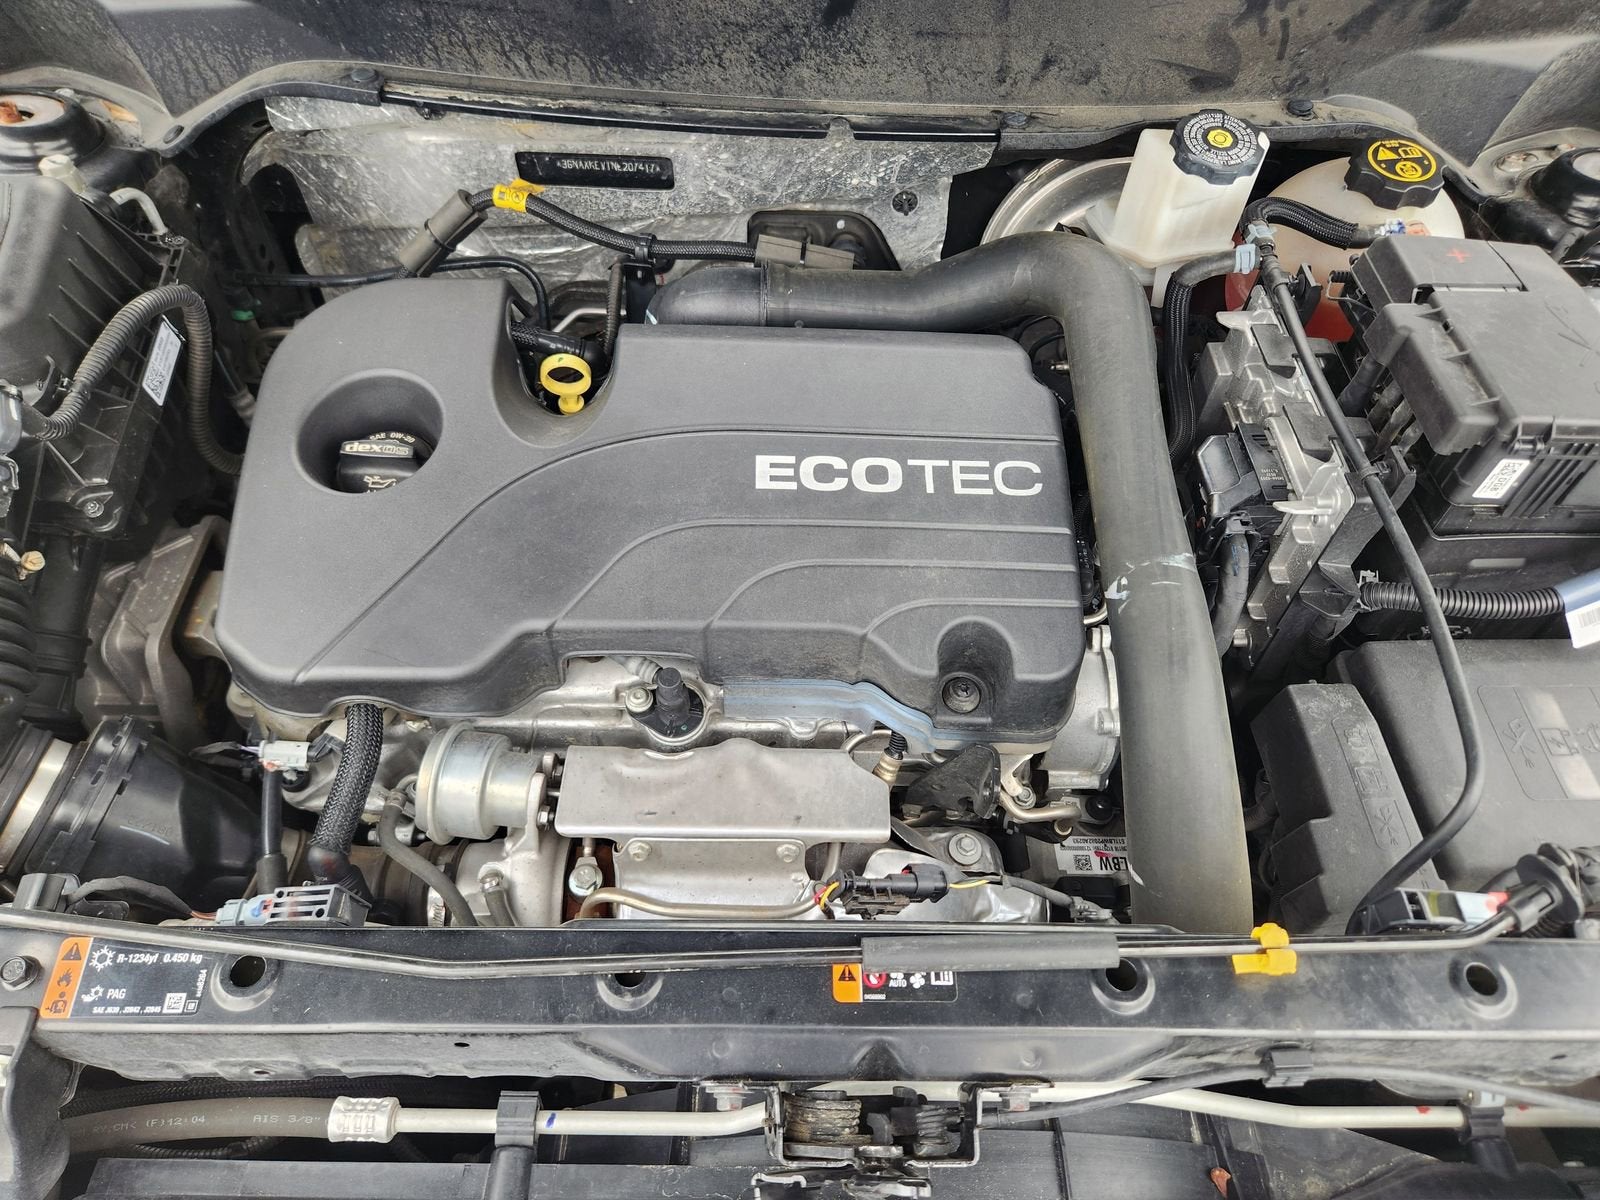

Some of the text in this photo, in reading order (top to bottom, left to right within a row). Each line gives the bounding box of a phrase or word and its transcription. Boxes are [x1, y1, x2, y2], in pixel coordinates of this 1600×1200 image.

[369, 432, 386, 441] SAE
[345, 442, 409, 456] dexos
[754, 454, 1043, 497] ECOTEC
[116, 952, 203, 965] R-1234yf 0.450 kg
[888, 979, 907, 988] AUTO
[106, 988, 127, 999] PAG
